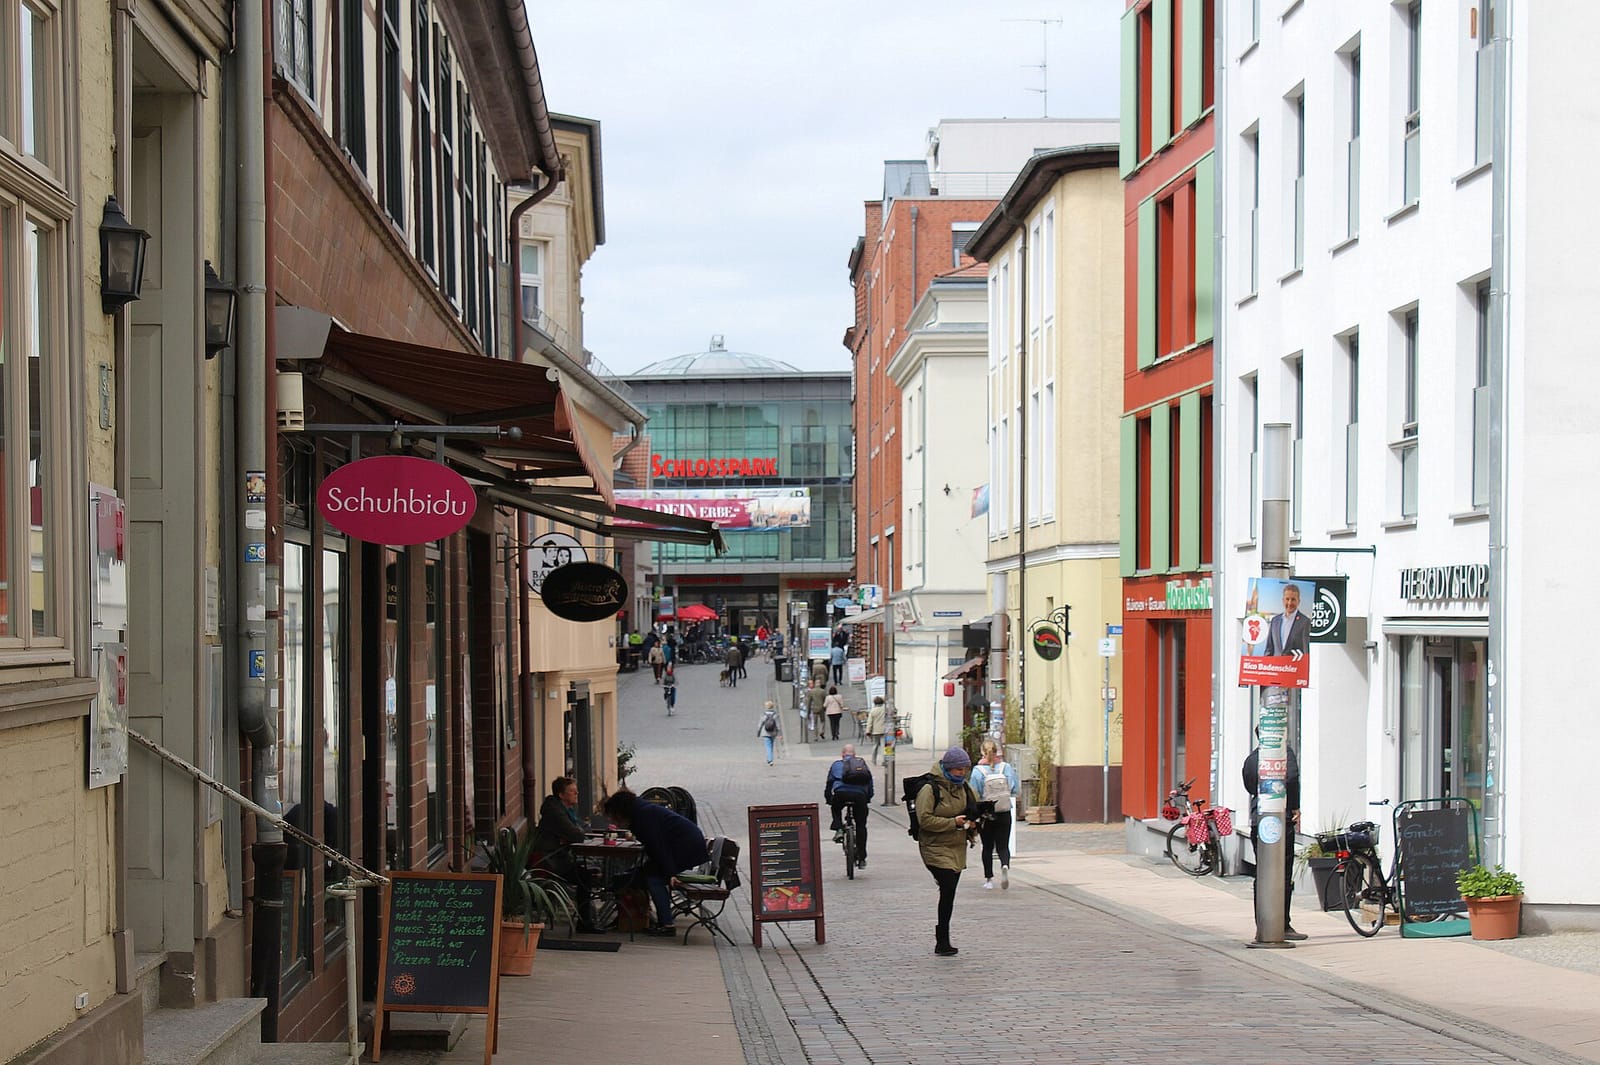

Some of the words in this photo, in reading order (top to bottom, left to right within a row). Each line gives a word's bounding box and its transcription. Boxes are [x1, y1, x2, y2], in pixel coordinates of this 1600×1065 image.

[652, 454, 778, 477] SCHLOSSPARK
[327, 487, 467, 516] Schuhbidu
[1418, 566, 1452, 601] BODY
[1312, 602, 1325, 610] HE
[1311, 619, 1330, 628] HOP
[413, 882, 430, 894] bin
[445, 897, 473, 908] Essen
